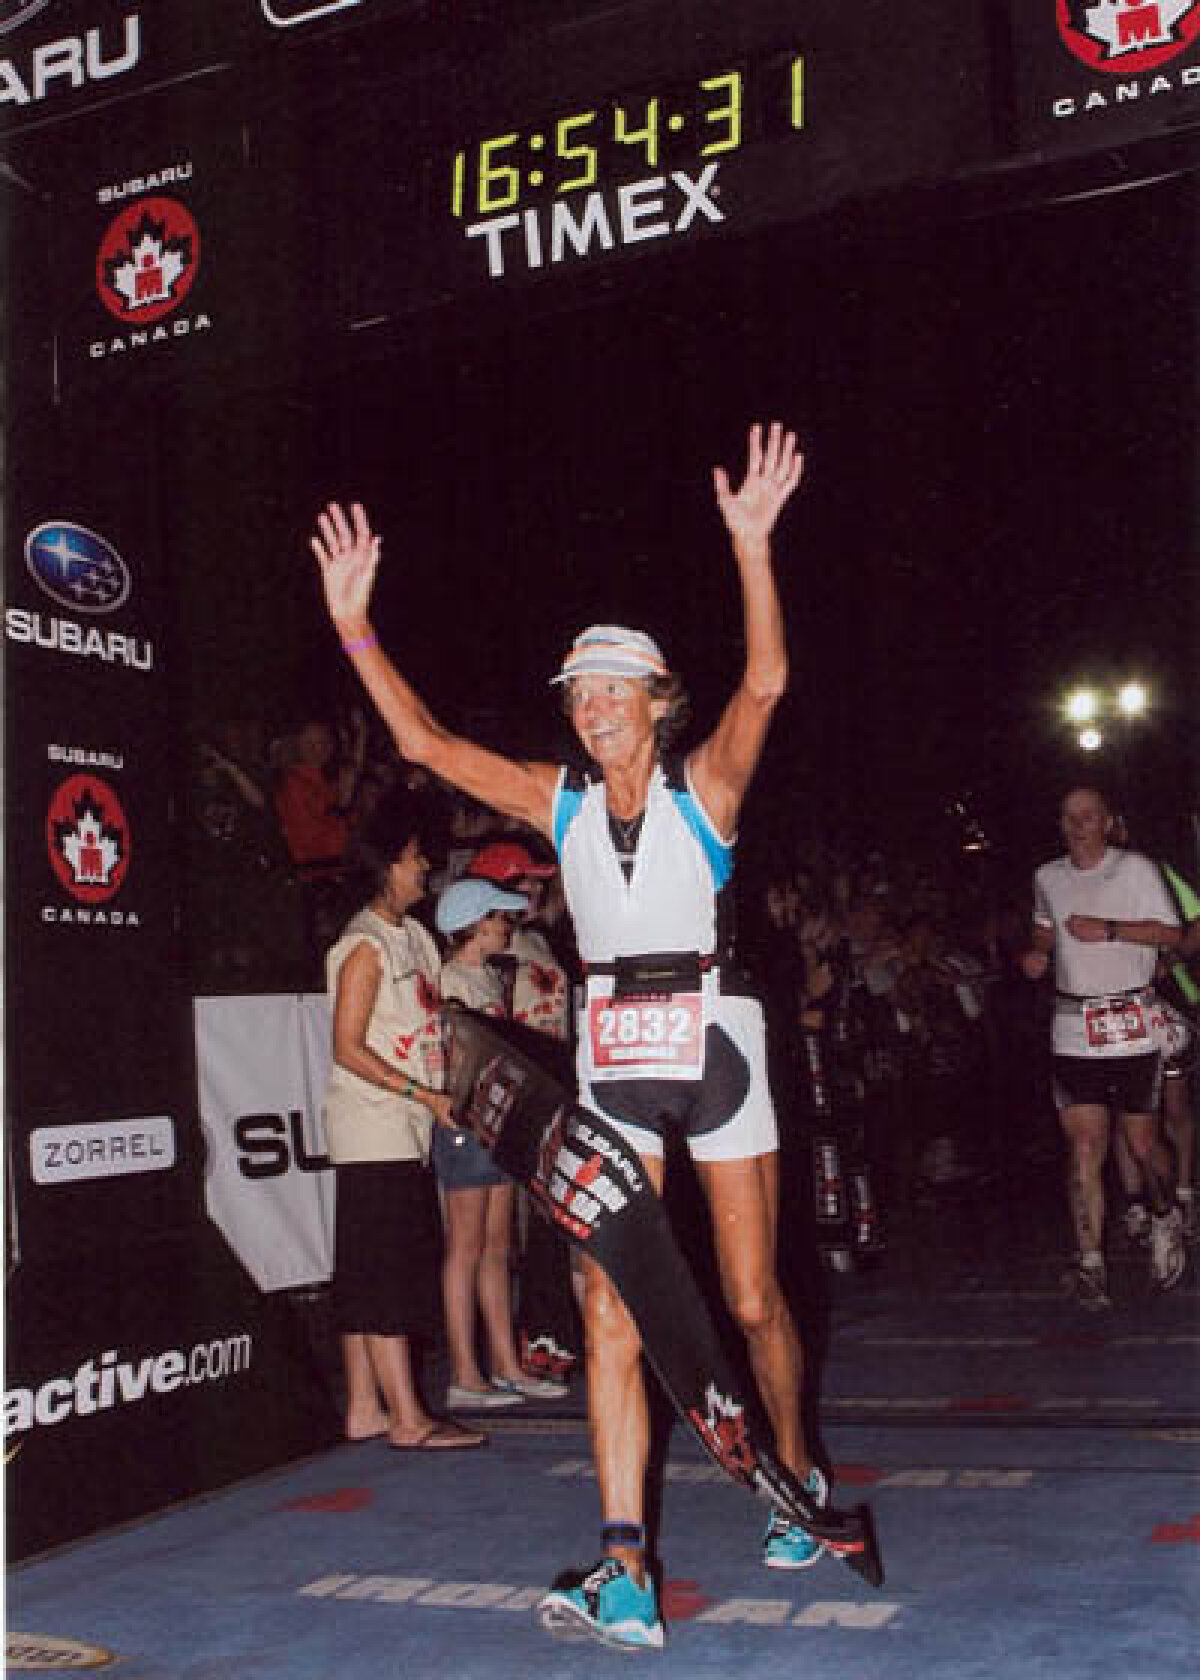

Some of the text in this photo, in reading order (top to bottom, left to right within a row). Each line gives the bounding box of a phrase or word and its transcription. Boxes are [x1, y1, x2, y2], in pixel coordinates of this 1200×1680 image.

[465, 161, 727, 278] TIMEX
[89, 314, 212, 358] CANADA
[5, 608, 153, 671] SUBARU
[41, 906, 140, 926] CANADA
[596, 1008, 694, 1045] 2832
[44, 1133, 165, 1168] ZORREL
[3, 1334, 251, 1438] active.com
